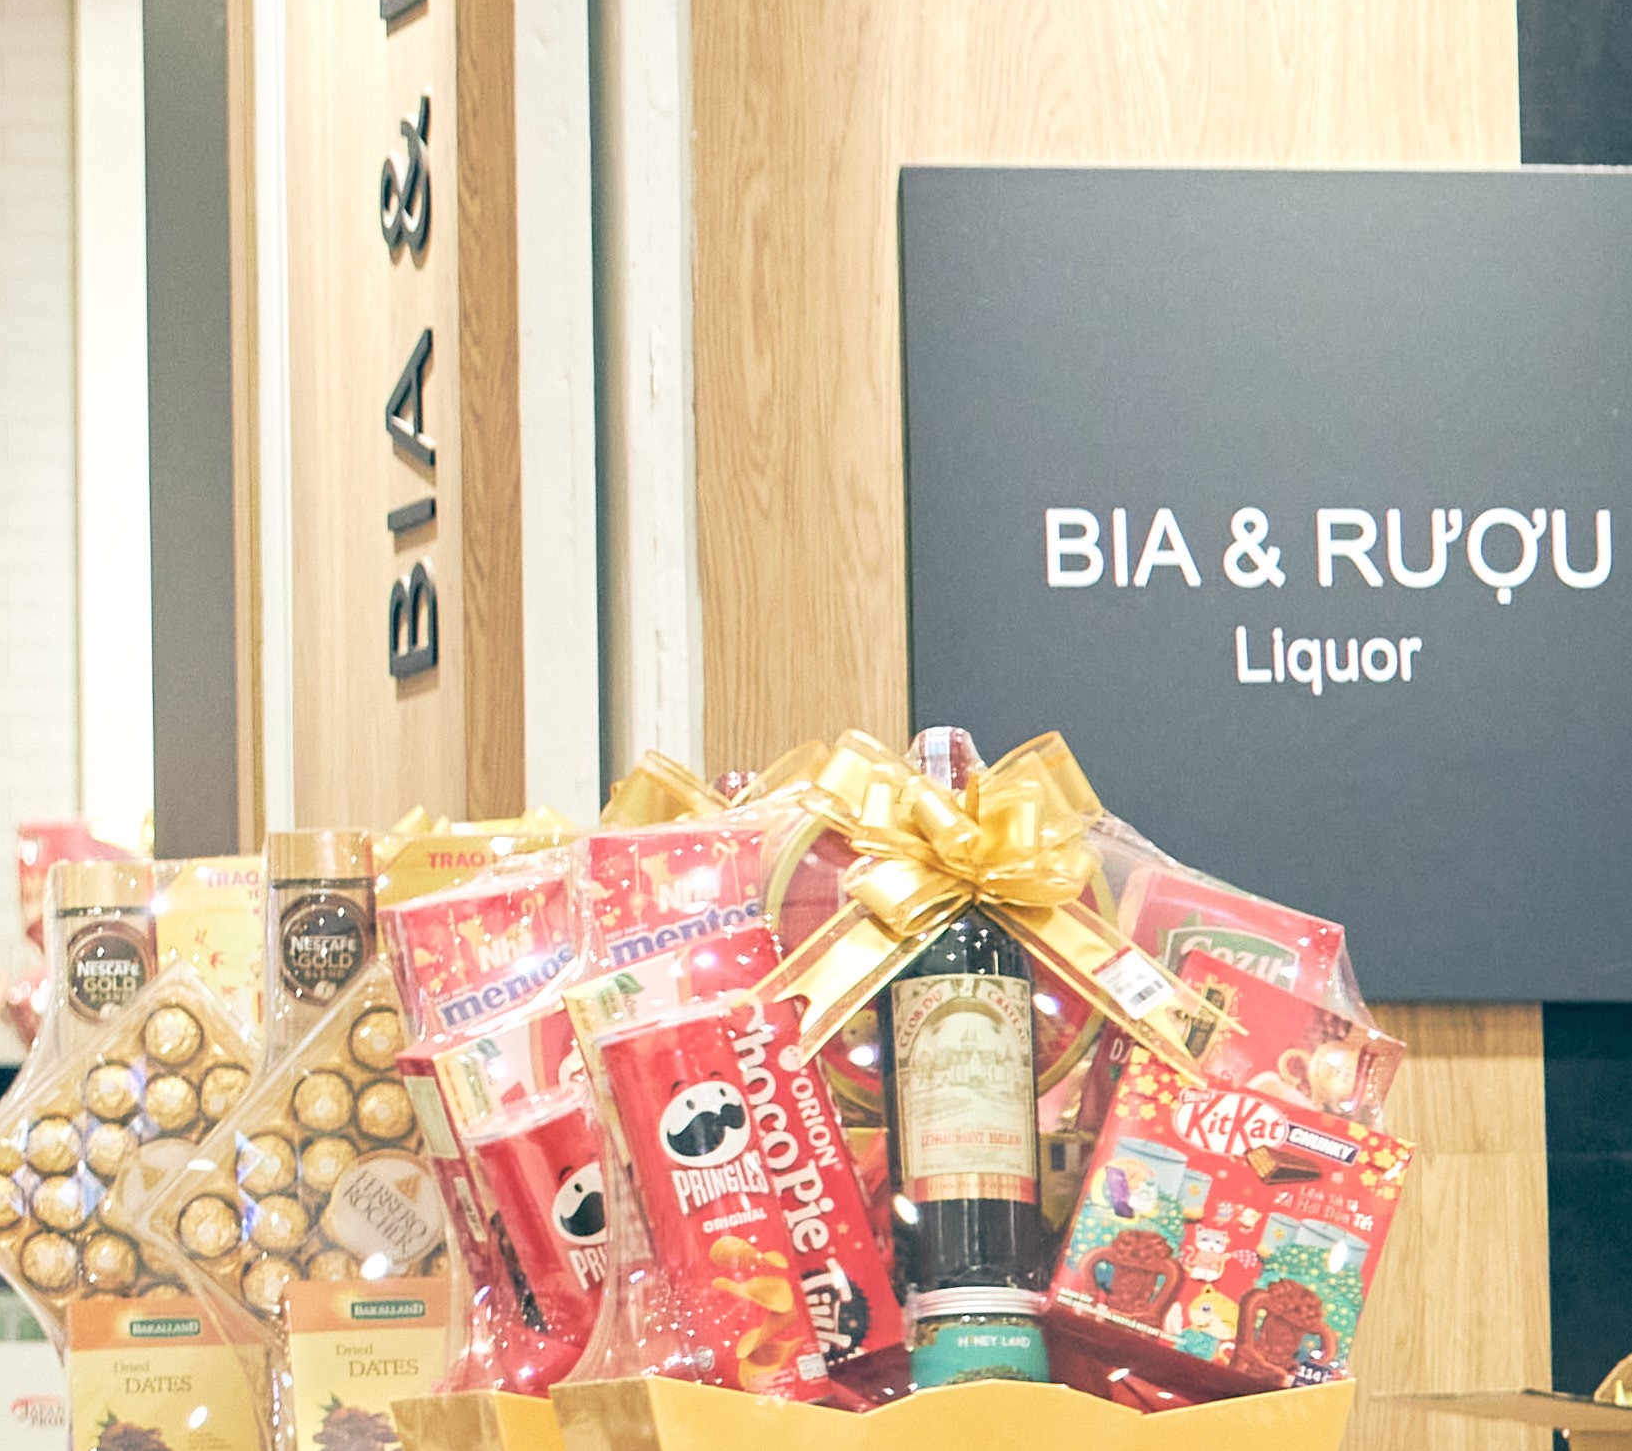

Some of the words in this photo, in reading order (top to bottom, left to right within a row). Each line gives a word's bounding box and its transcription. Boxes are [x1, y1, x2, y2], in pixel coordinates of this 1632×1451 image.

[379, 91, 435, 265] &
[385, 325, 439, 687] BIA
[1043, 506, 1202, 589] BIA
[1221, 505, 1286, 589] &
[1315, 506, 1614, 606] RƯỢU
[1234, 625, 1423, 696] Liquor
[609, 901, 763, 968] mentos
[83, 975, 137, 993] GOLD
[790, 1075, 839, 1169] ORION
[671, 1149, 770, 1216] PRINGLES
[702, 1210, 768, 1235] ORIGINAL
[335, 1344, 374, 1357] Dried
[348, 1359, 420, 1378] DATES
[124, 1376, 193, 1395] DATES
